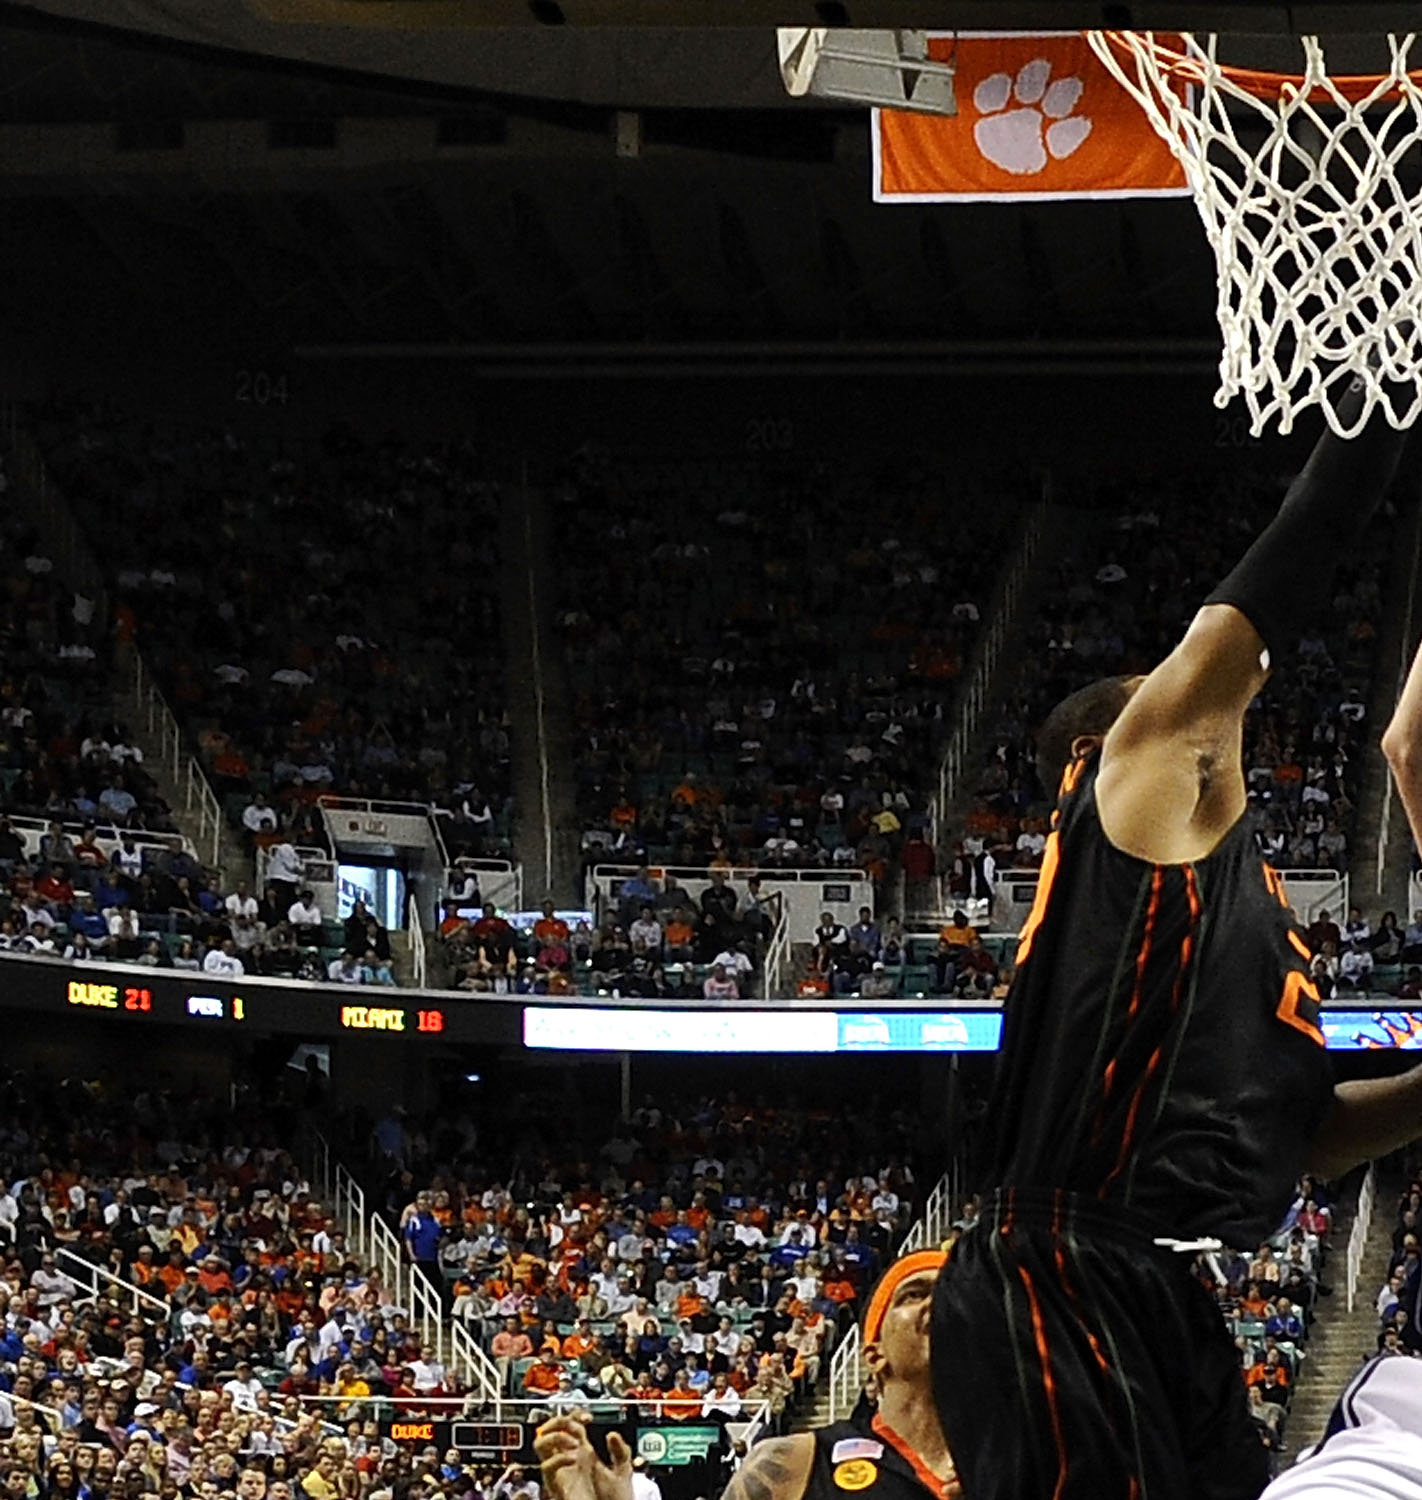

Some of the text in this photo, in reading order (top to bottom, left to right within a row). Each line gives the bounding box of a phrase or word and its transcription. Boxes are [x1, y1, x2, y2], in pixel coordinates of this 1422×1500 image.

[234, 370, 289, 405] 204
[69, 982, 151, 1011] DUKE 21
[233, 997, 244, 1020] 1
[342, 1006, 404, 1031] MIAMI
[391, 1423, 434, 1440] DUKE
